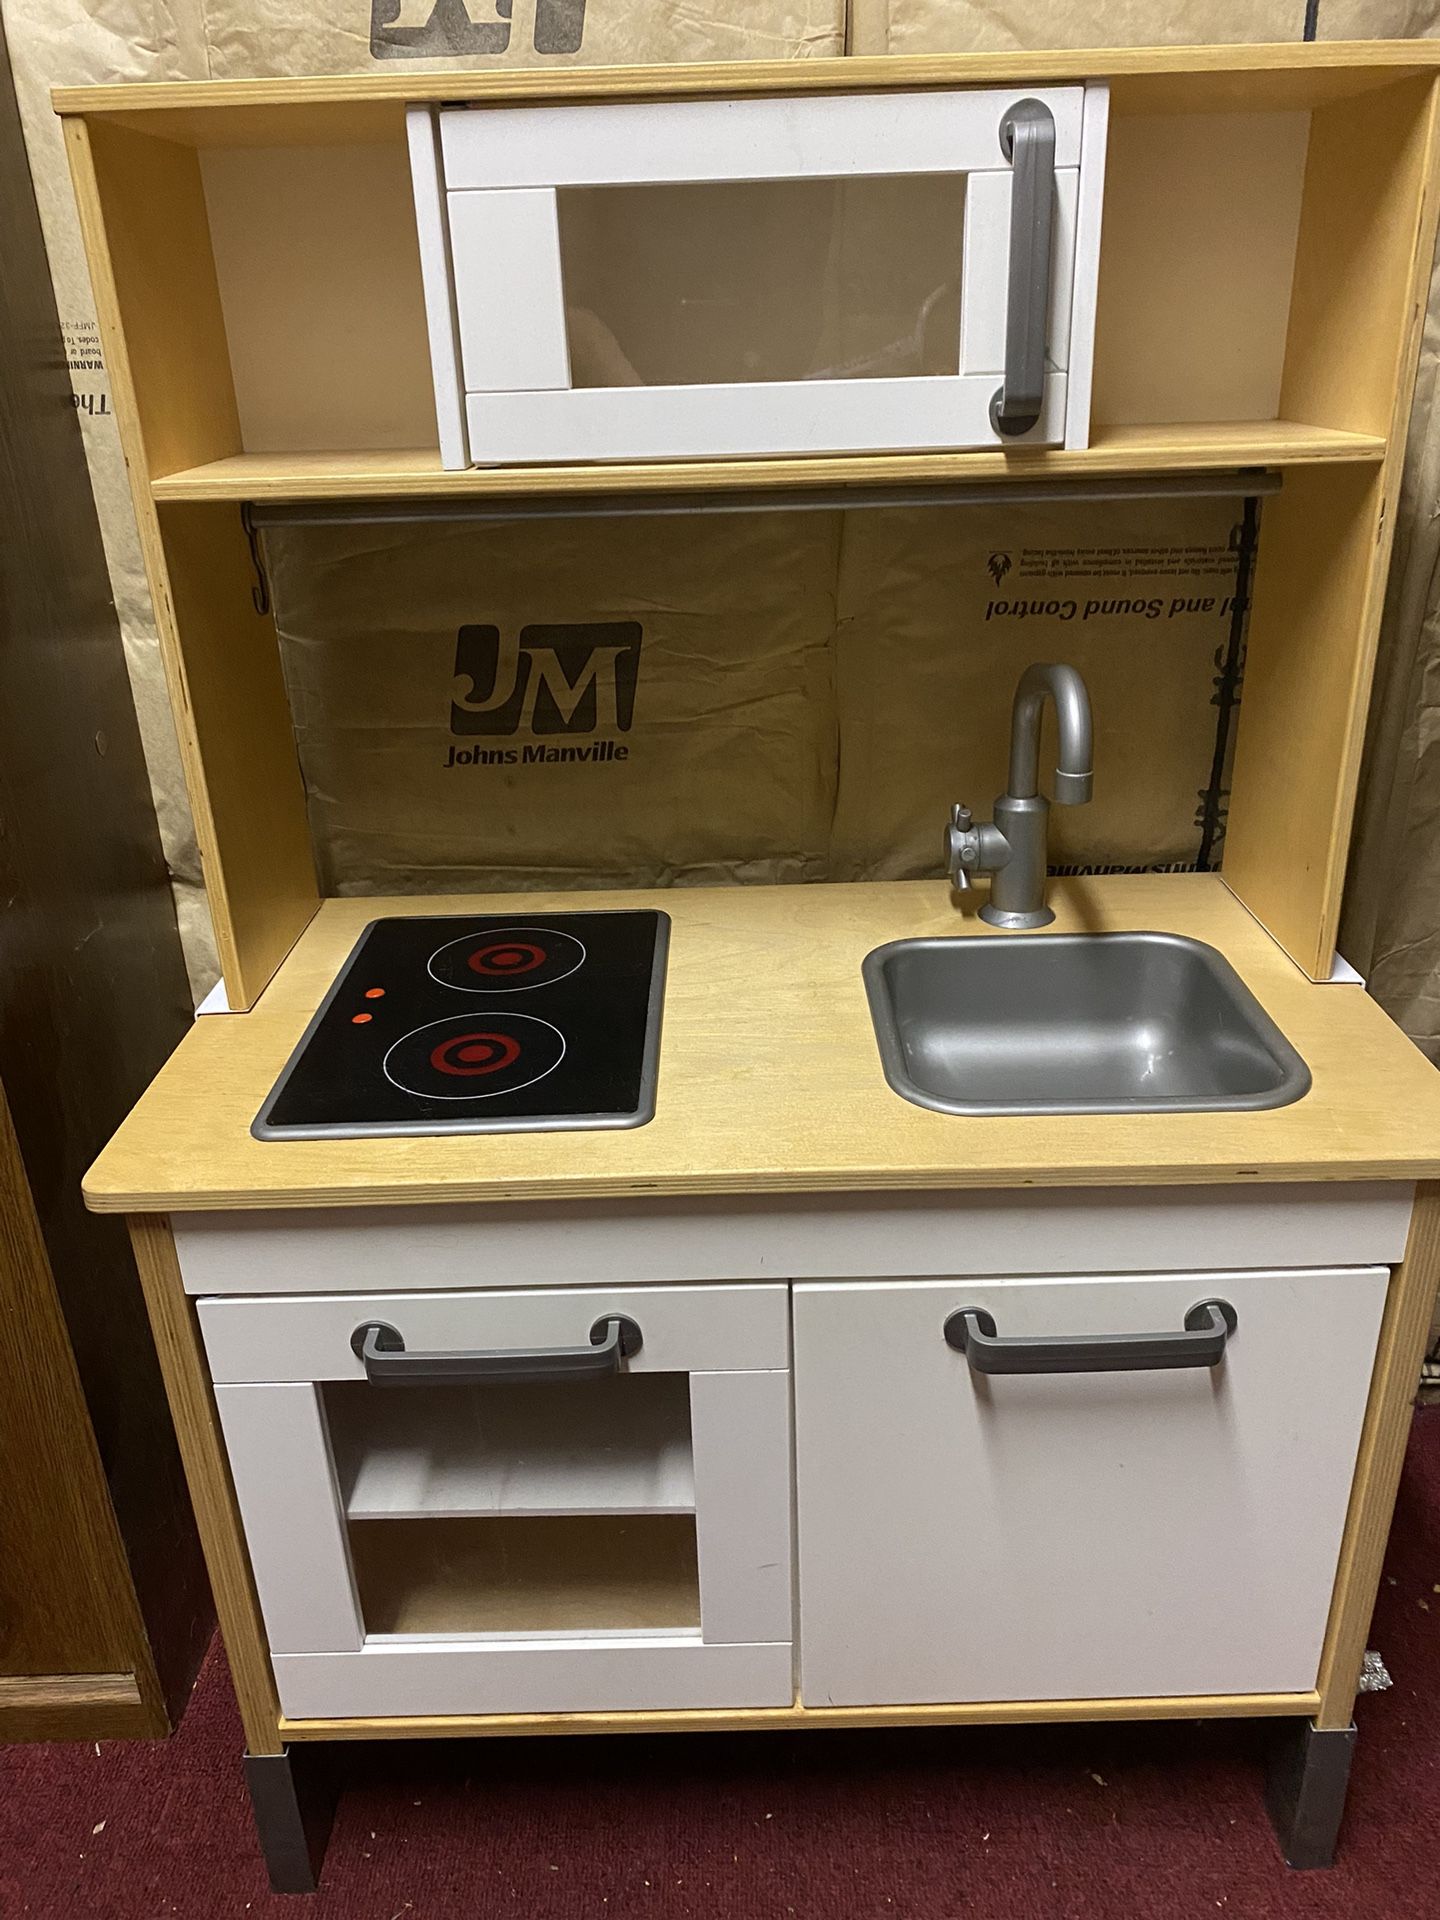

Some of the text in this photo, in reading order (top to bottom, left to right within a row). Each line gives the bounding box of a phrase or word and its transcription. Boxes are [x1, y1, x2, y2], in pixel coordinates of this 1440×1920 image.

[79, 349, 102, 357] board
[985, 599, 1077, 622] Control
[1082, 598, 1164, 621] Sound
[1168, 597, 1216, 618] and
[443, 740, 630, 769] Johns Manville
